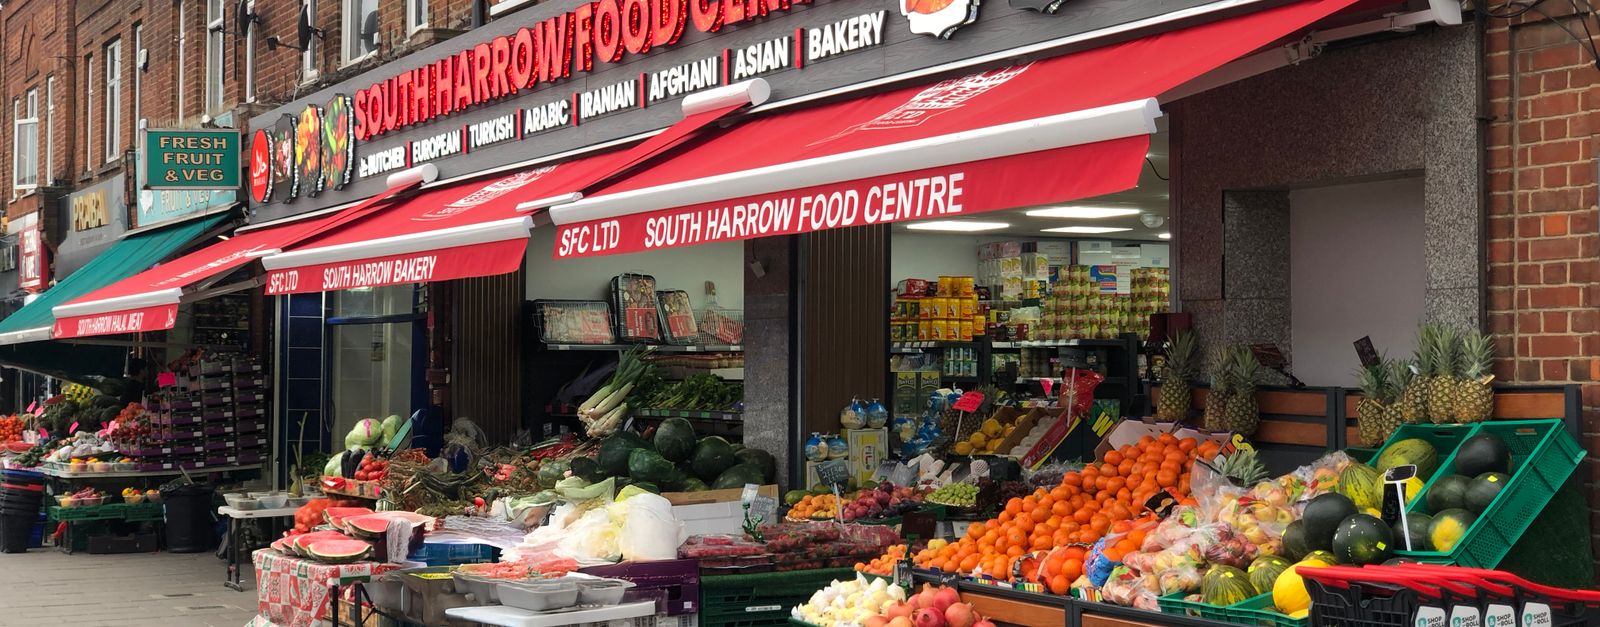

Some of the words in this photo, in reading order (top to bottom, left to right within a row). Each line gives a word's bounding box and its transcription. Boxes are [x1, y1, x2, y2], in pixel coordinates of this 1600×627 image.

[354, 64, 431, 141] SOUTH
[435, 12, 571, 116] HARROW
[575, 0, 682, 71] FOOD
[368, 147, 405, 176] BUTCHER
[413, 130, 461, 163] EUROPEAN
[469, 114, 515, 148] TURKISH
[524, 99, 568, 134] ARABIC
[580, 79, 635, 119] IRANIAN
[649, 56, 717, 101] AFGHANI
[733, 36, 788, 80] ASIAN
[808, 10, 885, 60] BAKERY
[160, 136, 227, 149] FRESH
[163, 152, 224, 165] FRUIT
[165, 169, 178, 182] &
[182, 169, 224, 181] VEG
[559, 226, 590, 257] SFC
[591, 220, 620, 251] LTD
[644, 210, 702, 249] SOUTH
[706, 196, 796, 240] HARROW
[798, 189, 858, 233] FOOD
[864, 172, 965, 221] CENTRE
[268, 275, 285, 293] SFC
[285, 270, 299, 291] LTD
[322, 265, 350, 290] SOUTH
[351, 259, 394, 287] HARROW
[394, 255, 437, 283] BAKERY
[77, 319, 94, 336] SOUTH
[92, 316, 113, 335] HARROW
[127, 312, 144, 331] MEAT
[1427, 616, 1442, 624] SHOP
[1461, 614, 1476, 623] SHOP
[1496, 613, 1511, 622] SHOP
[1533, 611, 1547, 619] SHOP
